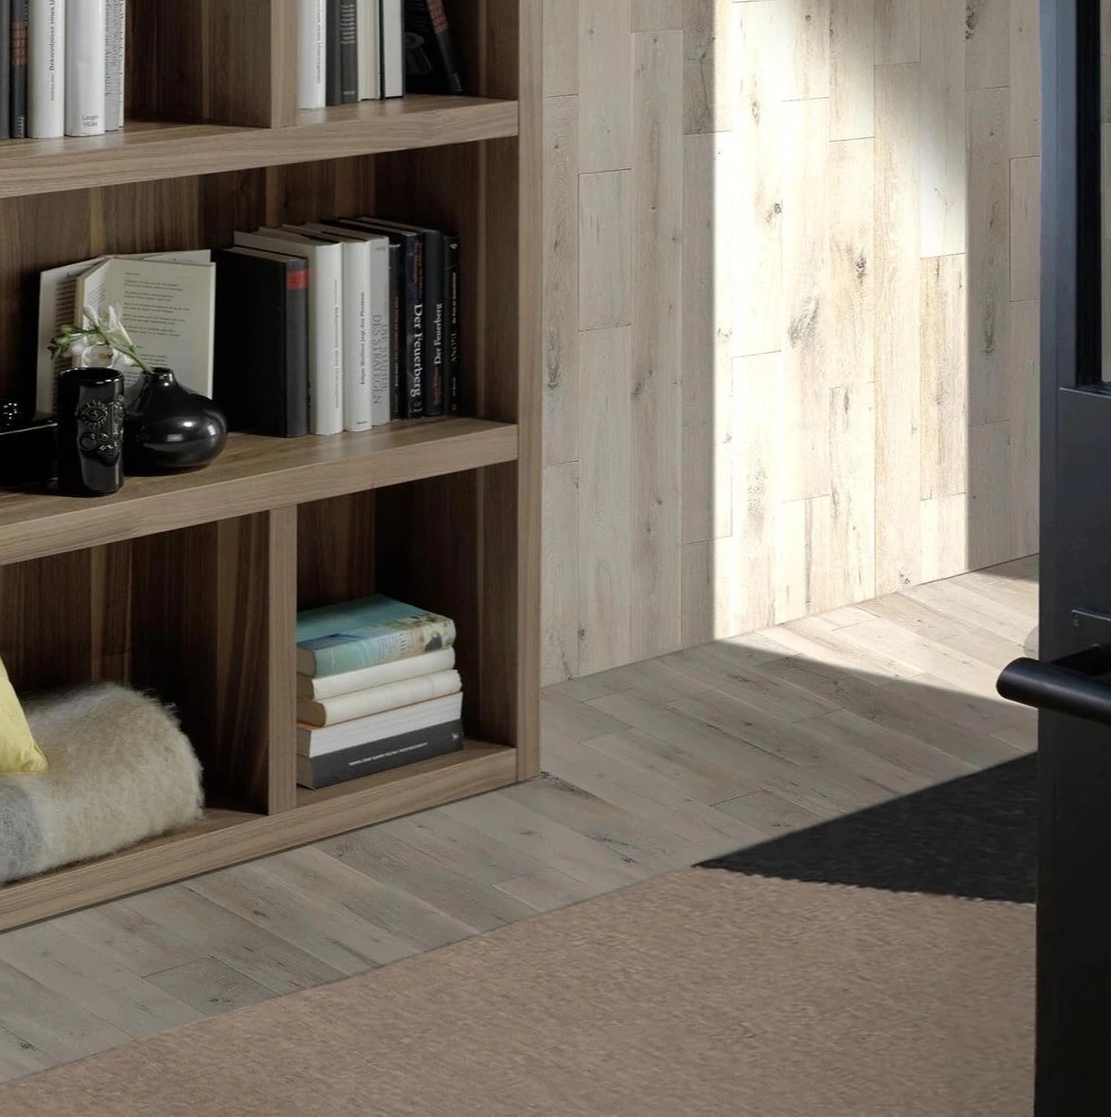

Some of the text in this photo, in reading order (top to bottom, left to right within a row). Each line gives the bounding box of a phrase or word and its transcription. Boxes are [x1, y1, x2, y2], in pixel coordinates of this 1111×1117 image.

[372, 314, 382, 404] DES STRATEGEN
[410, 303, 424, 397] Der Feuerberg
[434, 303, 443, 346] Feuerberg
